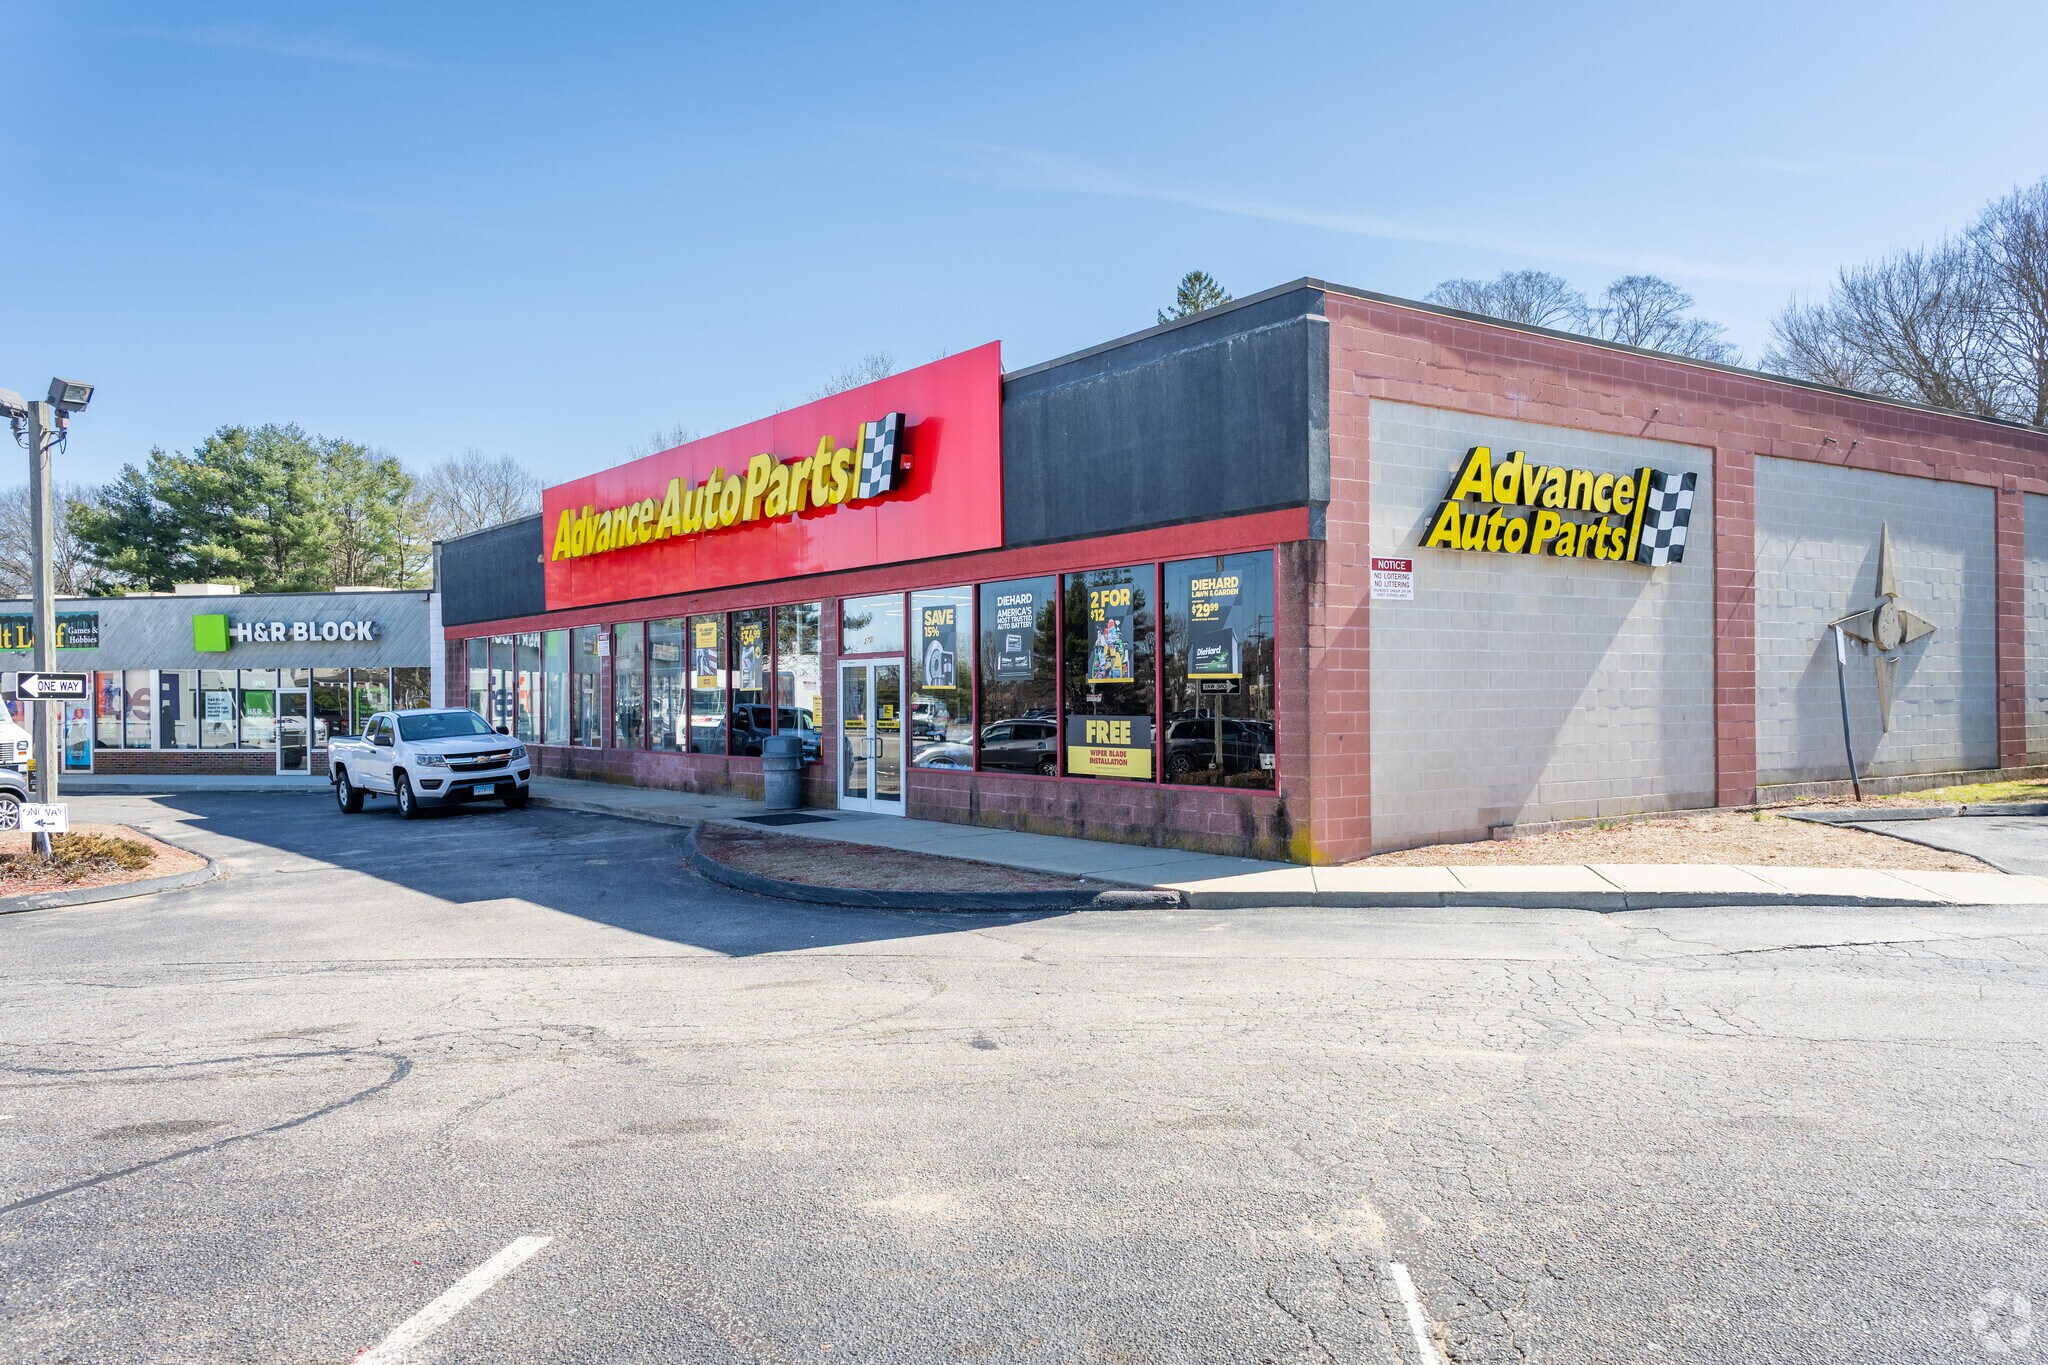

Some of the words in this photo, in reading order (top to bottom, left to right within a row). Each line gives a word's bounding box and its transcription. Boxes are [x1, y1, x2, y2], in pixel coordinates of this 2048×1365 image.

[1446, 446, 1636, 516] Advance
[551, 497, 661, 562] Advance
[655, 467, 747, 539] Auto
[742, 435, 856, 521] Parts
[1420, 501, 1529, 554] Auto
[1525, 510, 1627, 561] Parts
[1378, 560, 1406, 570] NOTICE
[1191, 576, 1239, 591] DIEHARD
[997, 593, 1033, 607] DIEHARD
[1090, 591, 1099, 608] 2
[1101, 588, 1131, 608] FOR
[924, 608, 954, 626] SAVE
[997, 607, 1032, 618] AMERICA'S
[1090, 608, 1105, 622] $12
[68, 626, 90, 634] Games
[237, 621, 287, 643] H&R
[293, 621, 374, 641] BLOCK
[924, 626, 940, 638] 15%
[1011, 621, 1032, 629] BATTERY
[16, 622, 67, 649] Lf
[69, 635, 97, 644] Hobbies
[1196, 645, 1221, 656] DieHard
[37, 681, 56, 691] ONE
[59, 681, 79, 691] WAY
[1086, 720, 1131, 745] FREE
[1090, 749, 1108, 757] WIPER
[1109, 750, 1127, 758] BLADE
[1089, 757, 1128, 766] INSTALLATION
